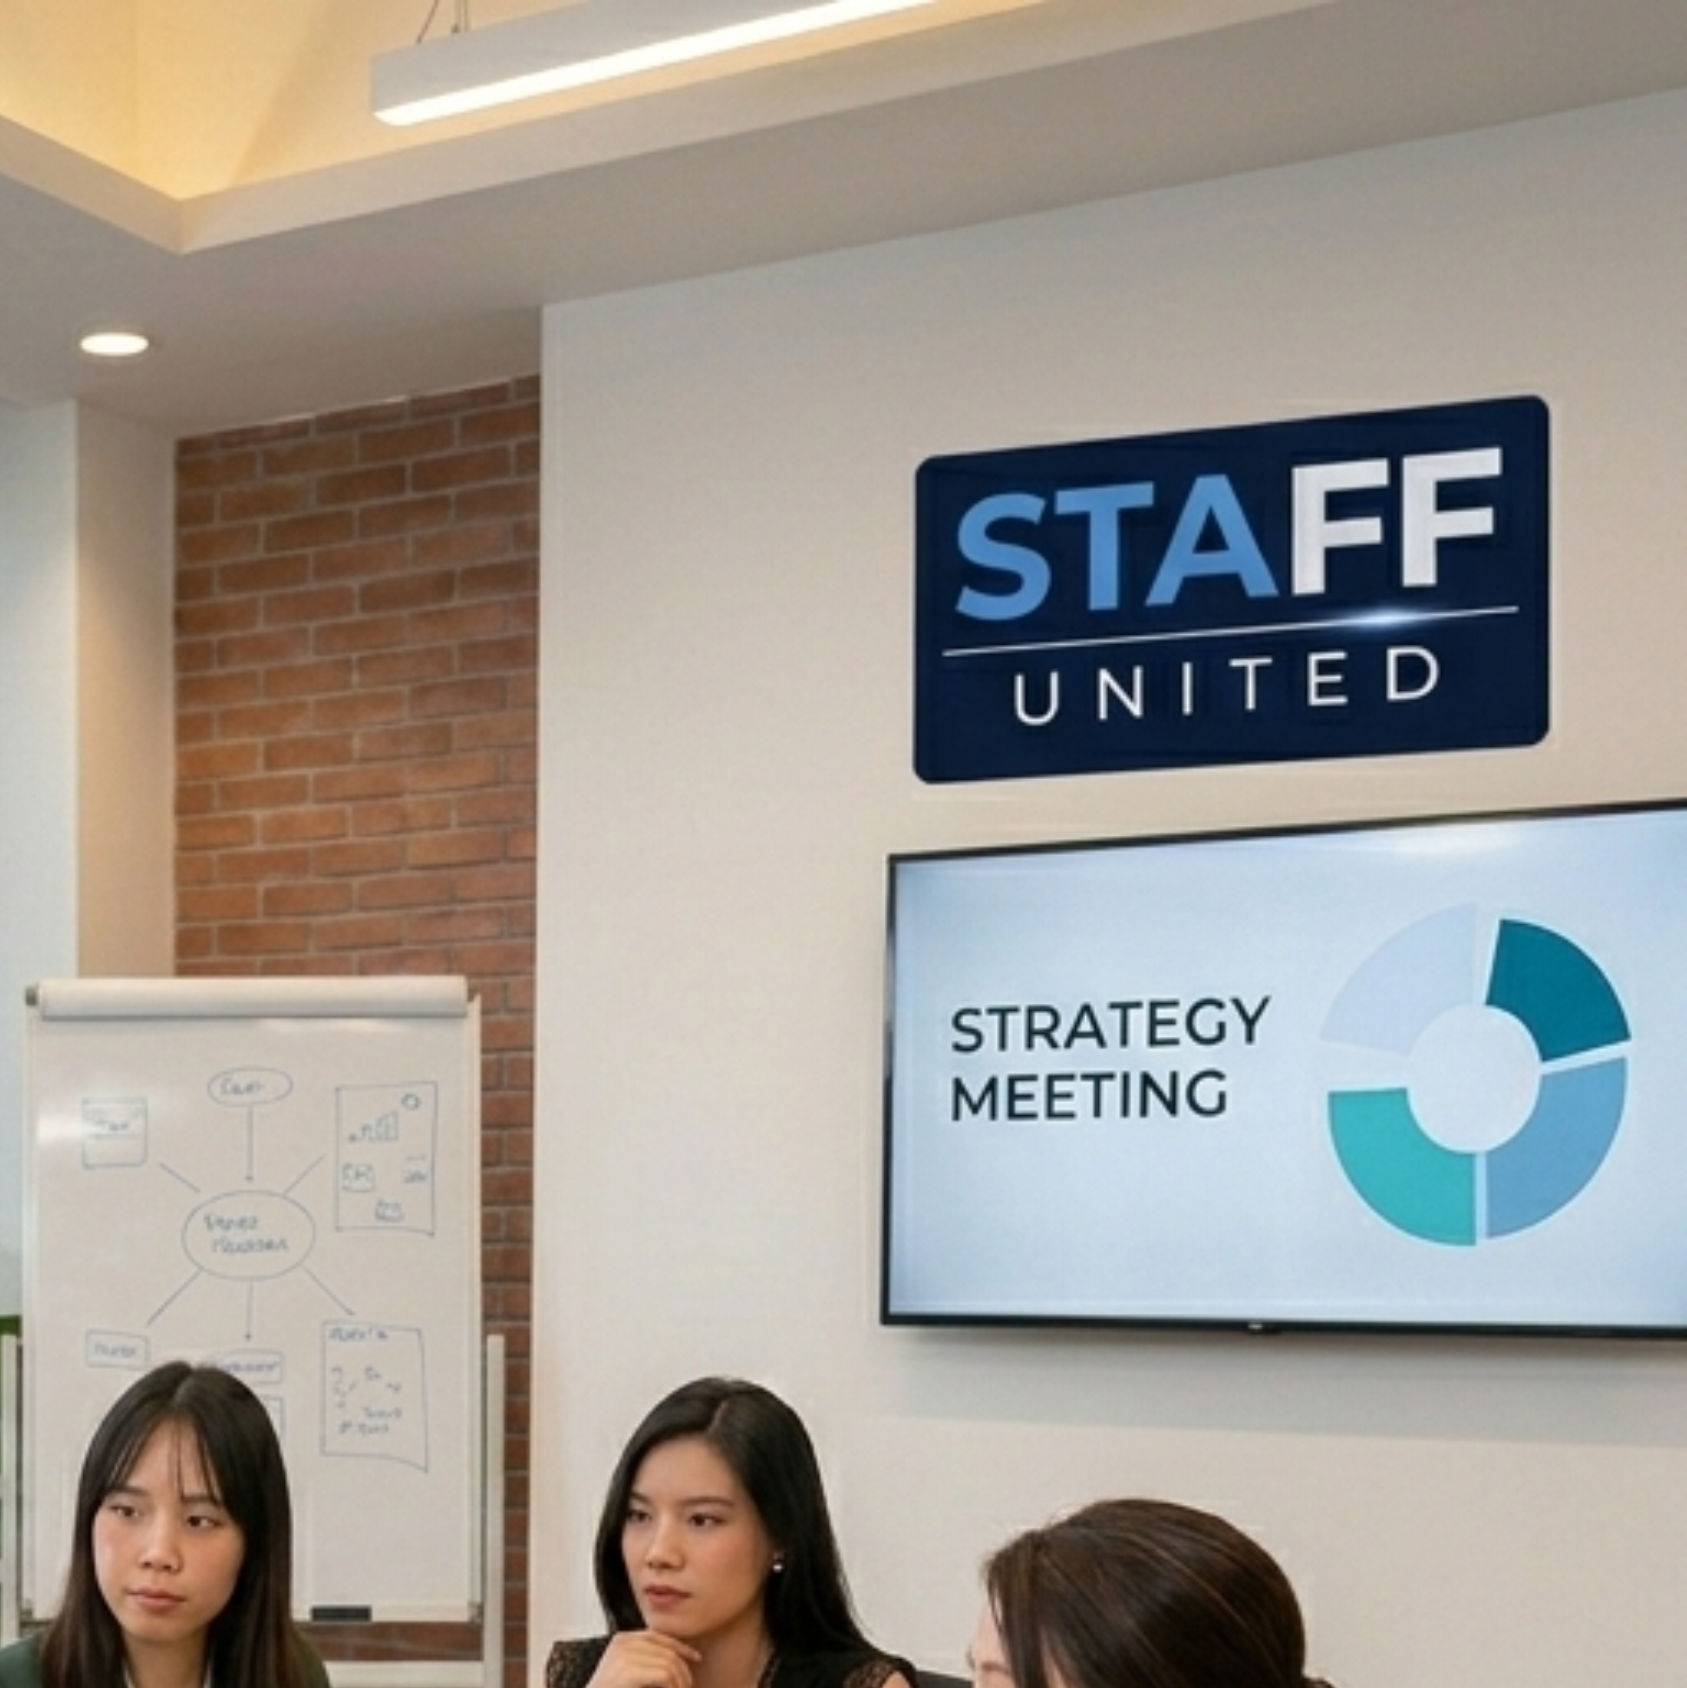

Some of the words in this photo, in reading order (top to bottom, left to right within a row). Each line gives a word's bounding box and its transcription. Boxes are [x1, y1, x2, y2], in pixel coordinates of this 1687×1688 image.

[955, 445, 1504, 622] STAFF
[1013, 645, 1440, 727] UNITED
[951, 995, 1271, 1054] STRATEGY
[951, 1068, 1227, 1123] MEETING
